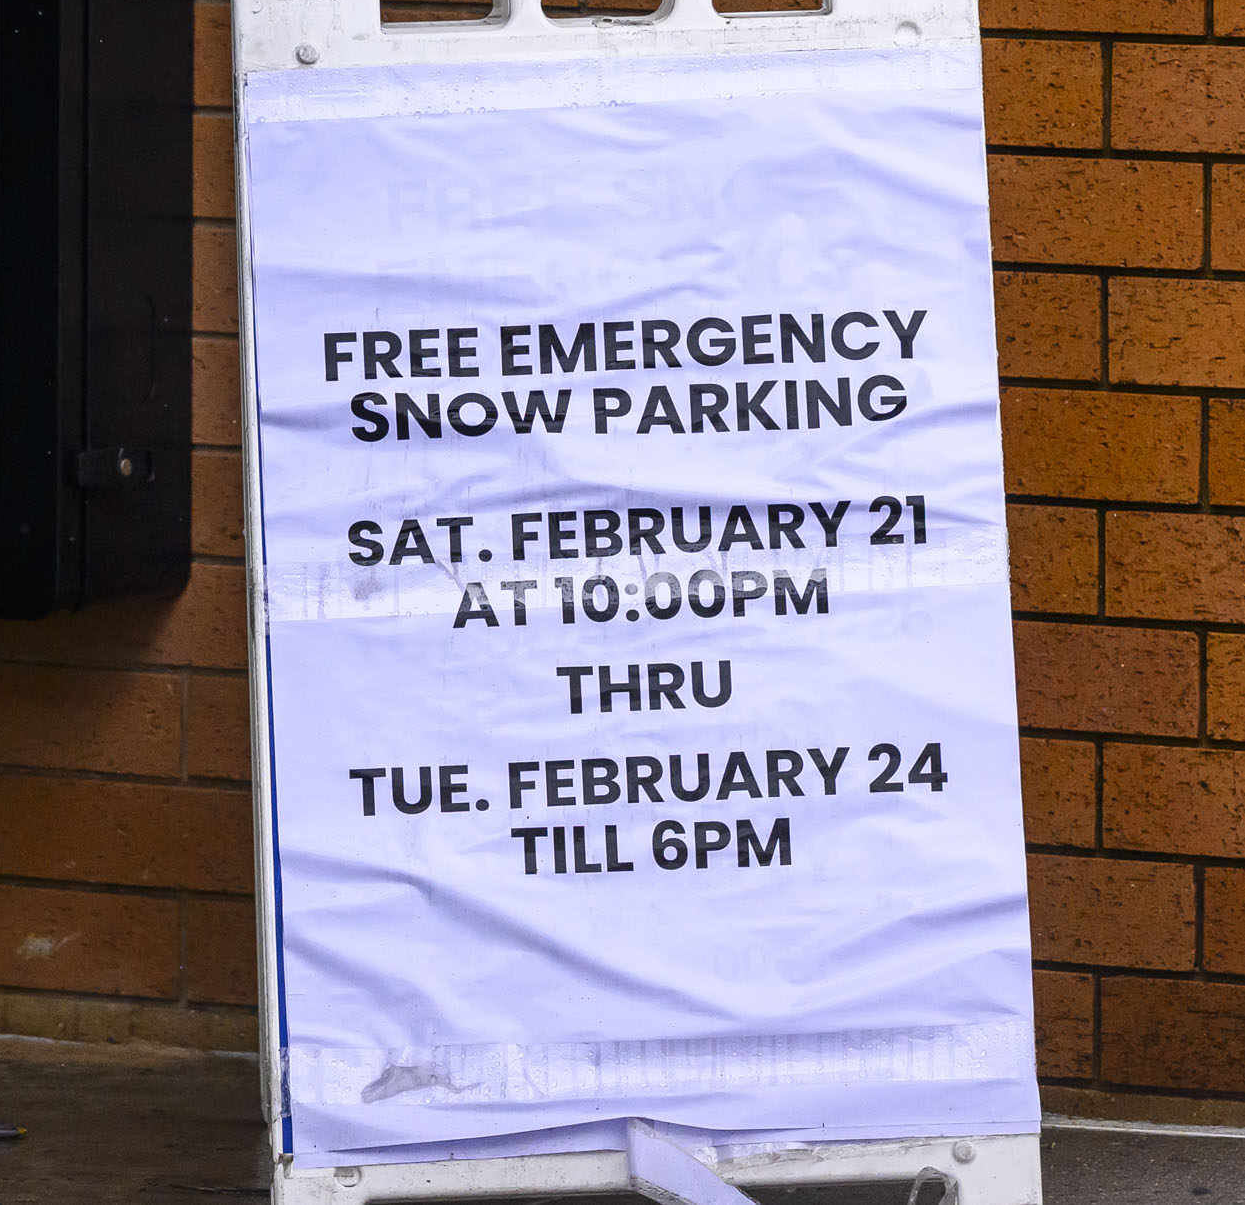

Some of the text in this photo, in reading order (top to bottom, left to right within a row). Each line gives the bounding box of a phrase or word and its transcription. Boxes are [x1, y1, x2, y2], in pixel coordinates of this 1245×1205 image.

[324, 310, 927, 381] FREE EMERGENCY
[351, 375, 907, 442] SNOW PARKING
[348, 495, 926, 566] SAT. FEBRUARY 21
[453, 570, 828, 628] AT 10:00PM
[556, 660, 731, 714] THRU
[349, 743, 948, 816] TUE. FEBRUARY 24
[511, 818, 791, 875] TILL 6PM
